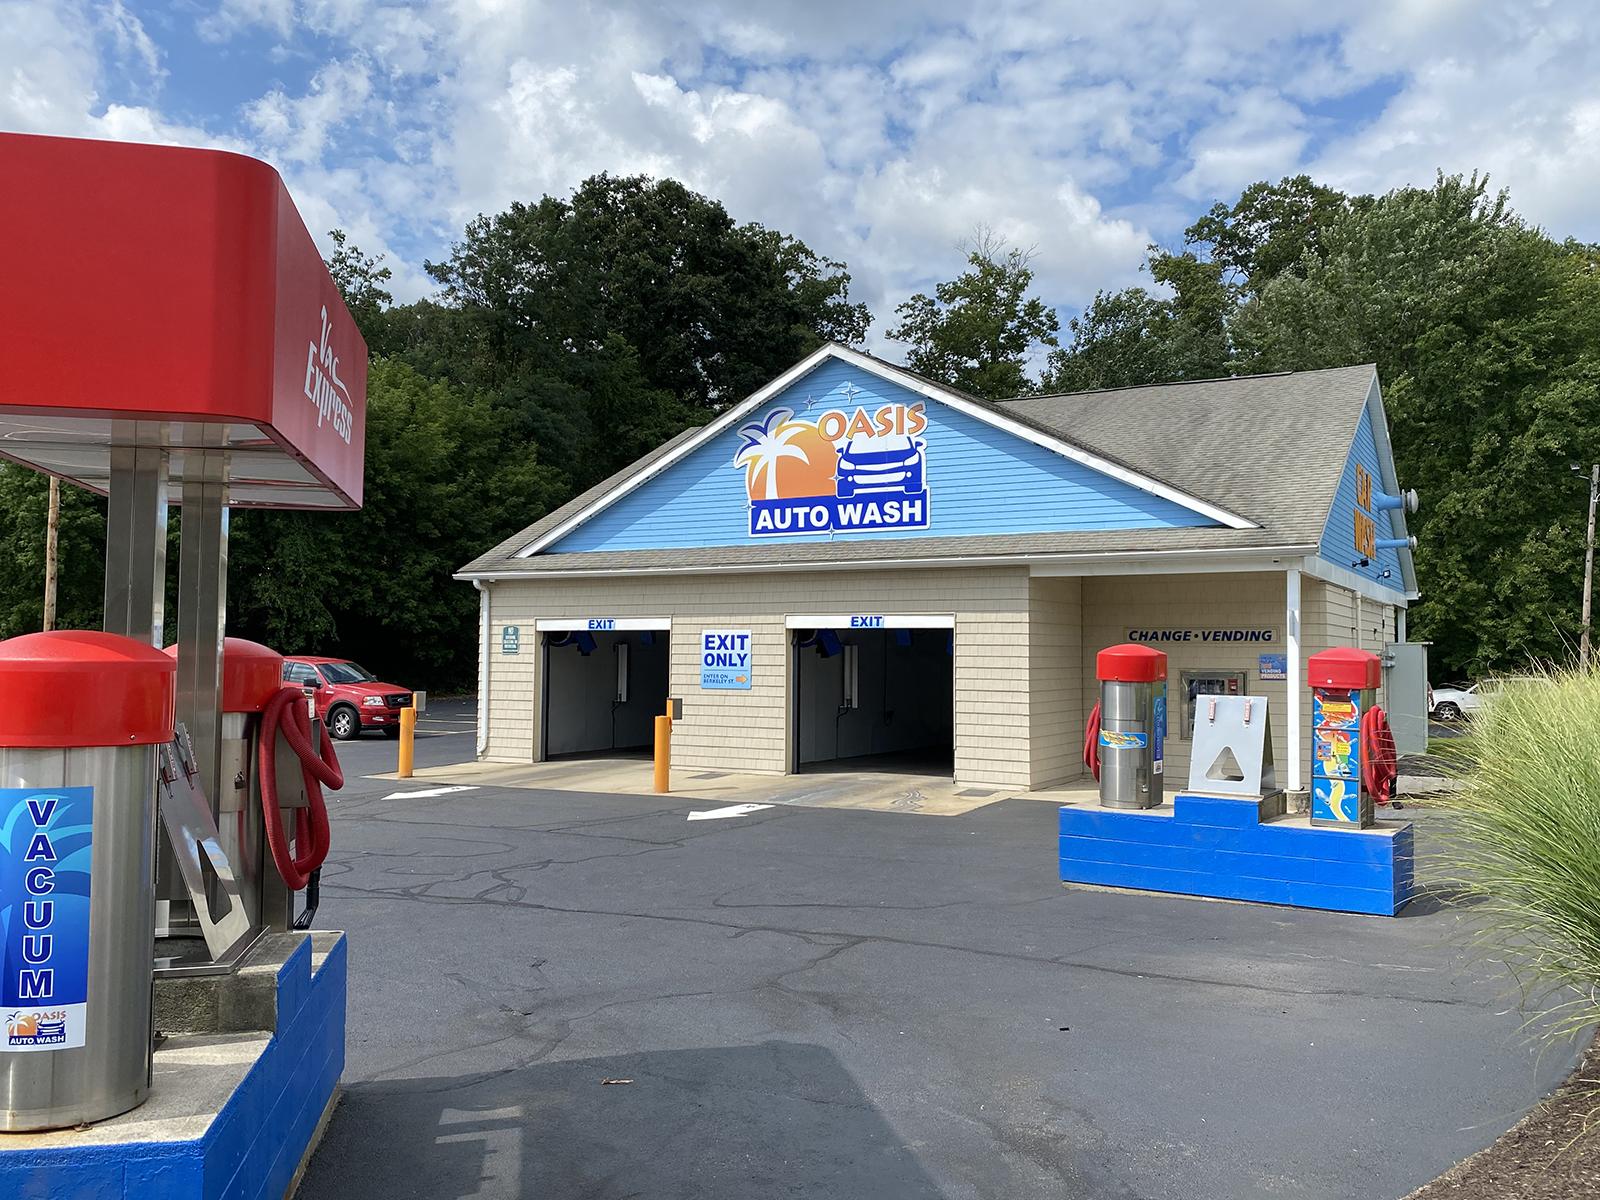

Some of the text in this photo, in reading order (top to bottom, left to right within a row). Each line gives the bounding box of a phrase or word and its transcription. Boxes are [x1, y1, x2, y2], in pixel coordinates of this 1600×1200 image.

[320, 304, 353, 408] Vac
[304, 341, 353, 445] Express
[817, 404, 926, 442] OASIS
[755, 499, 922, 531] AUTO WASH
[1353, 507, 1377, 561] WASH
[588, 619, 615, 630] EXIT
[850, 615, 883, 627] EXIT
[704, 634, 749, 651] EXIT
[1128, 630, 1273, 642] CHANGE VENDING
[703, 652, 748, 667] ONLY
[19, 798, 58, 999] VACUUM
[32, 1010, 67, 1021] OASIS
[9, 1037, 35, 1045] AUTO
